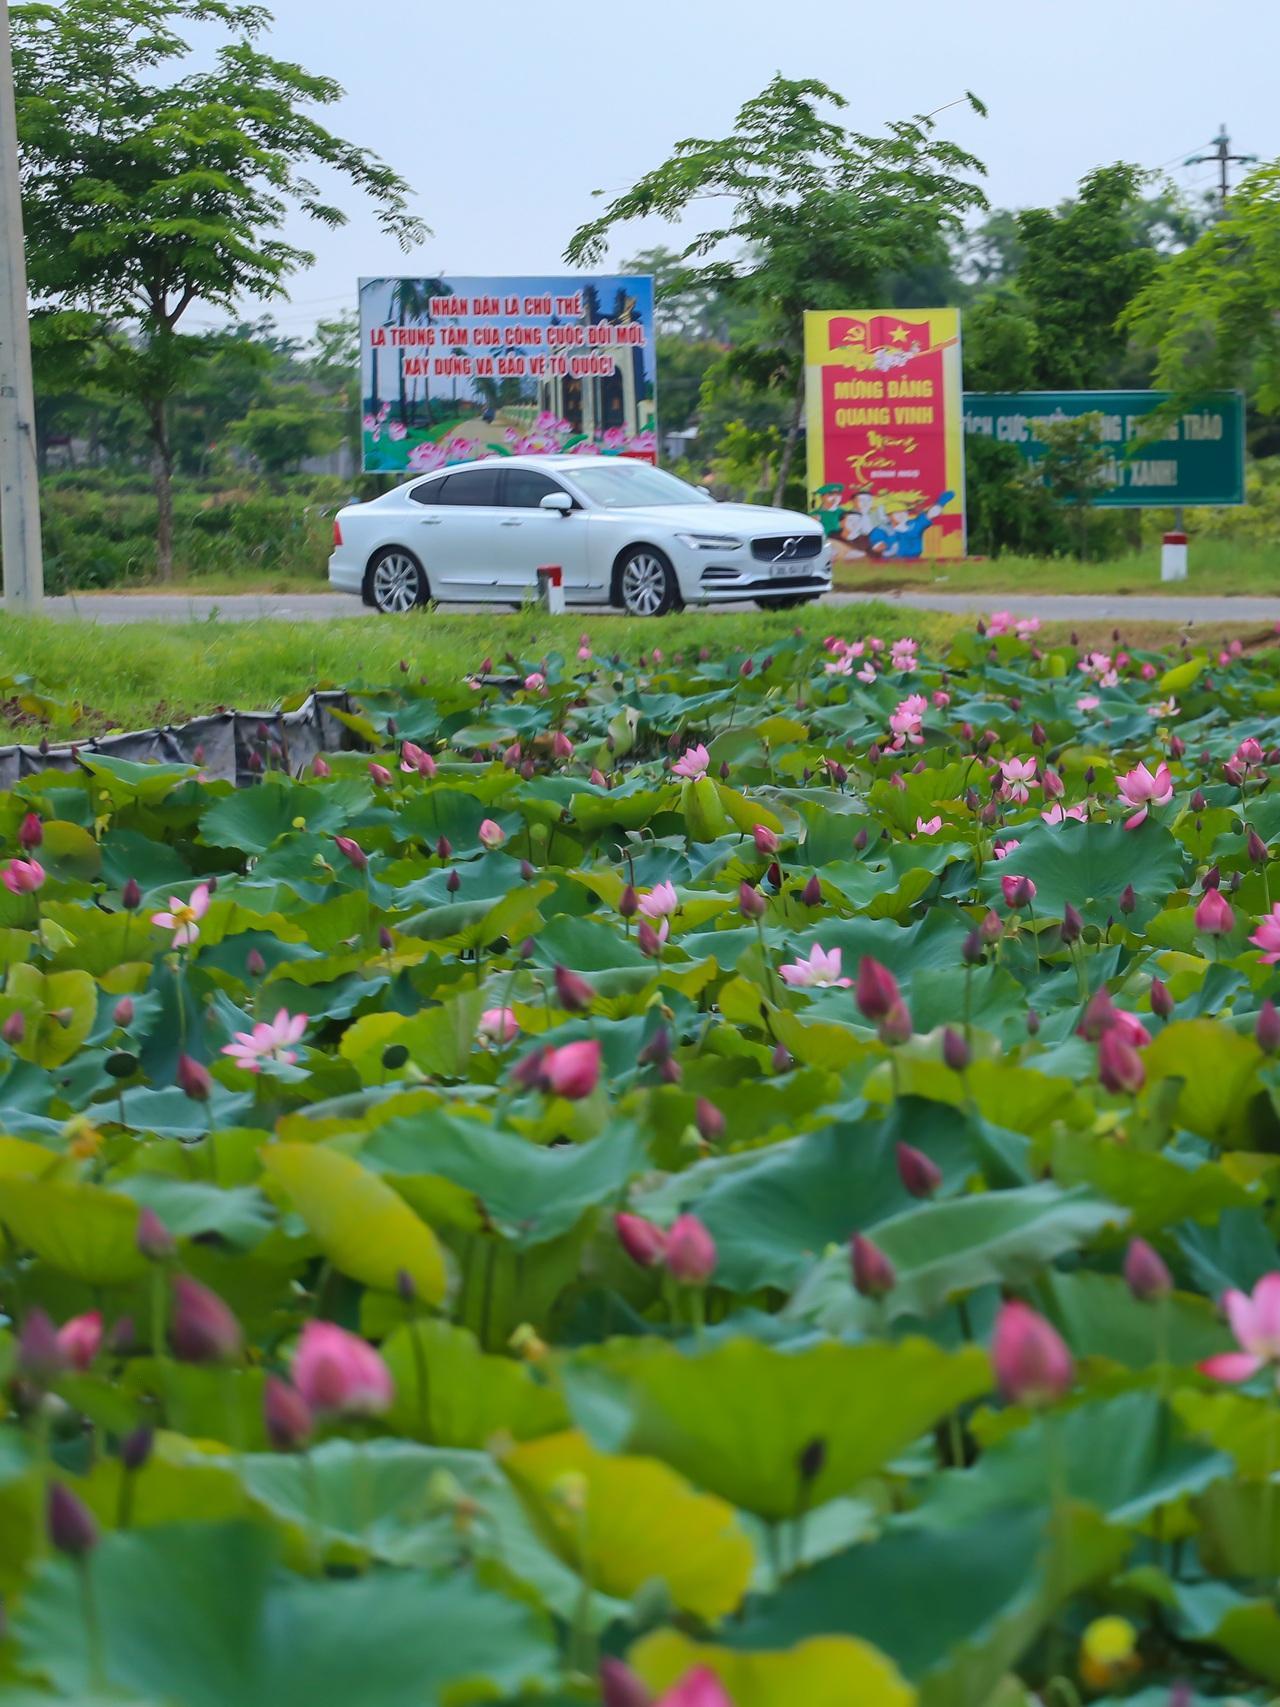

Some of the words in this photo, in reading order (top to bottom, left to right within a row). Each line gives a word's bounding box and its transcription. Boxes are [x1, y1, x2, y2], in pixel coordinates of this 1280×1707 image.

[431, 293, 468, 316] NHÂN
[473, 293, 500, 316] DÂN
[390, 327, 436, 347] TRUNG
[440, 324, 468, 347] TÂM
[473, 323, 500, 346] CỦA
[504, 323, 542, 346] CÔNG
[434, 354, 472, 378] DỰNG
[498, 351, 525, 376] BẢO
[834, 377, 884, 400] MỪNG
[888, 374, 934, 399] ĐẢNG
[835, 407, 890, 428] QUANG
[894, 406, 934, 425] VINH
